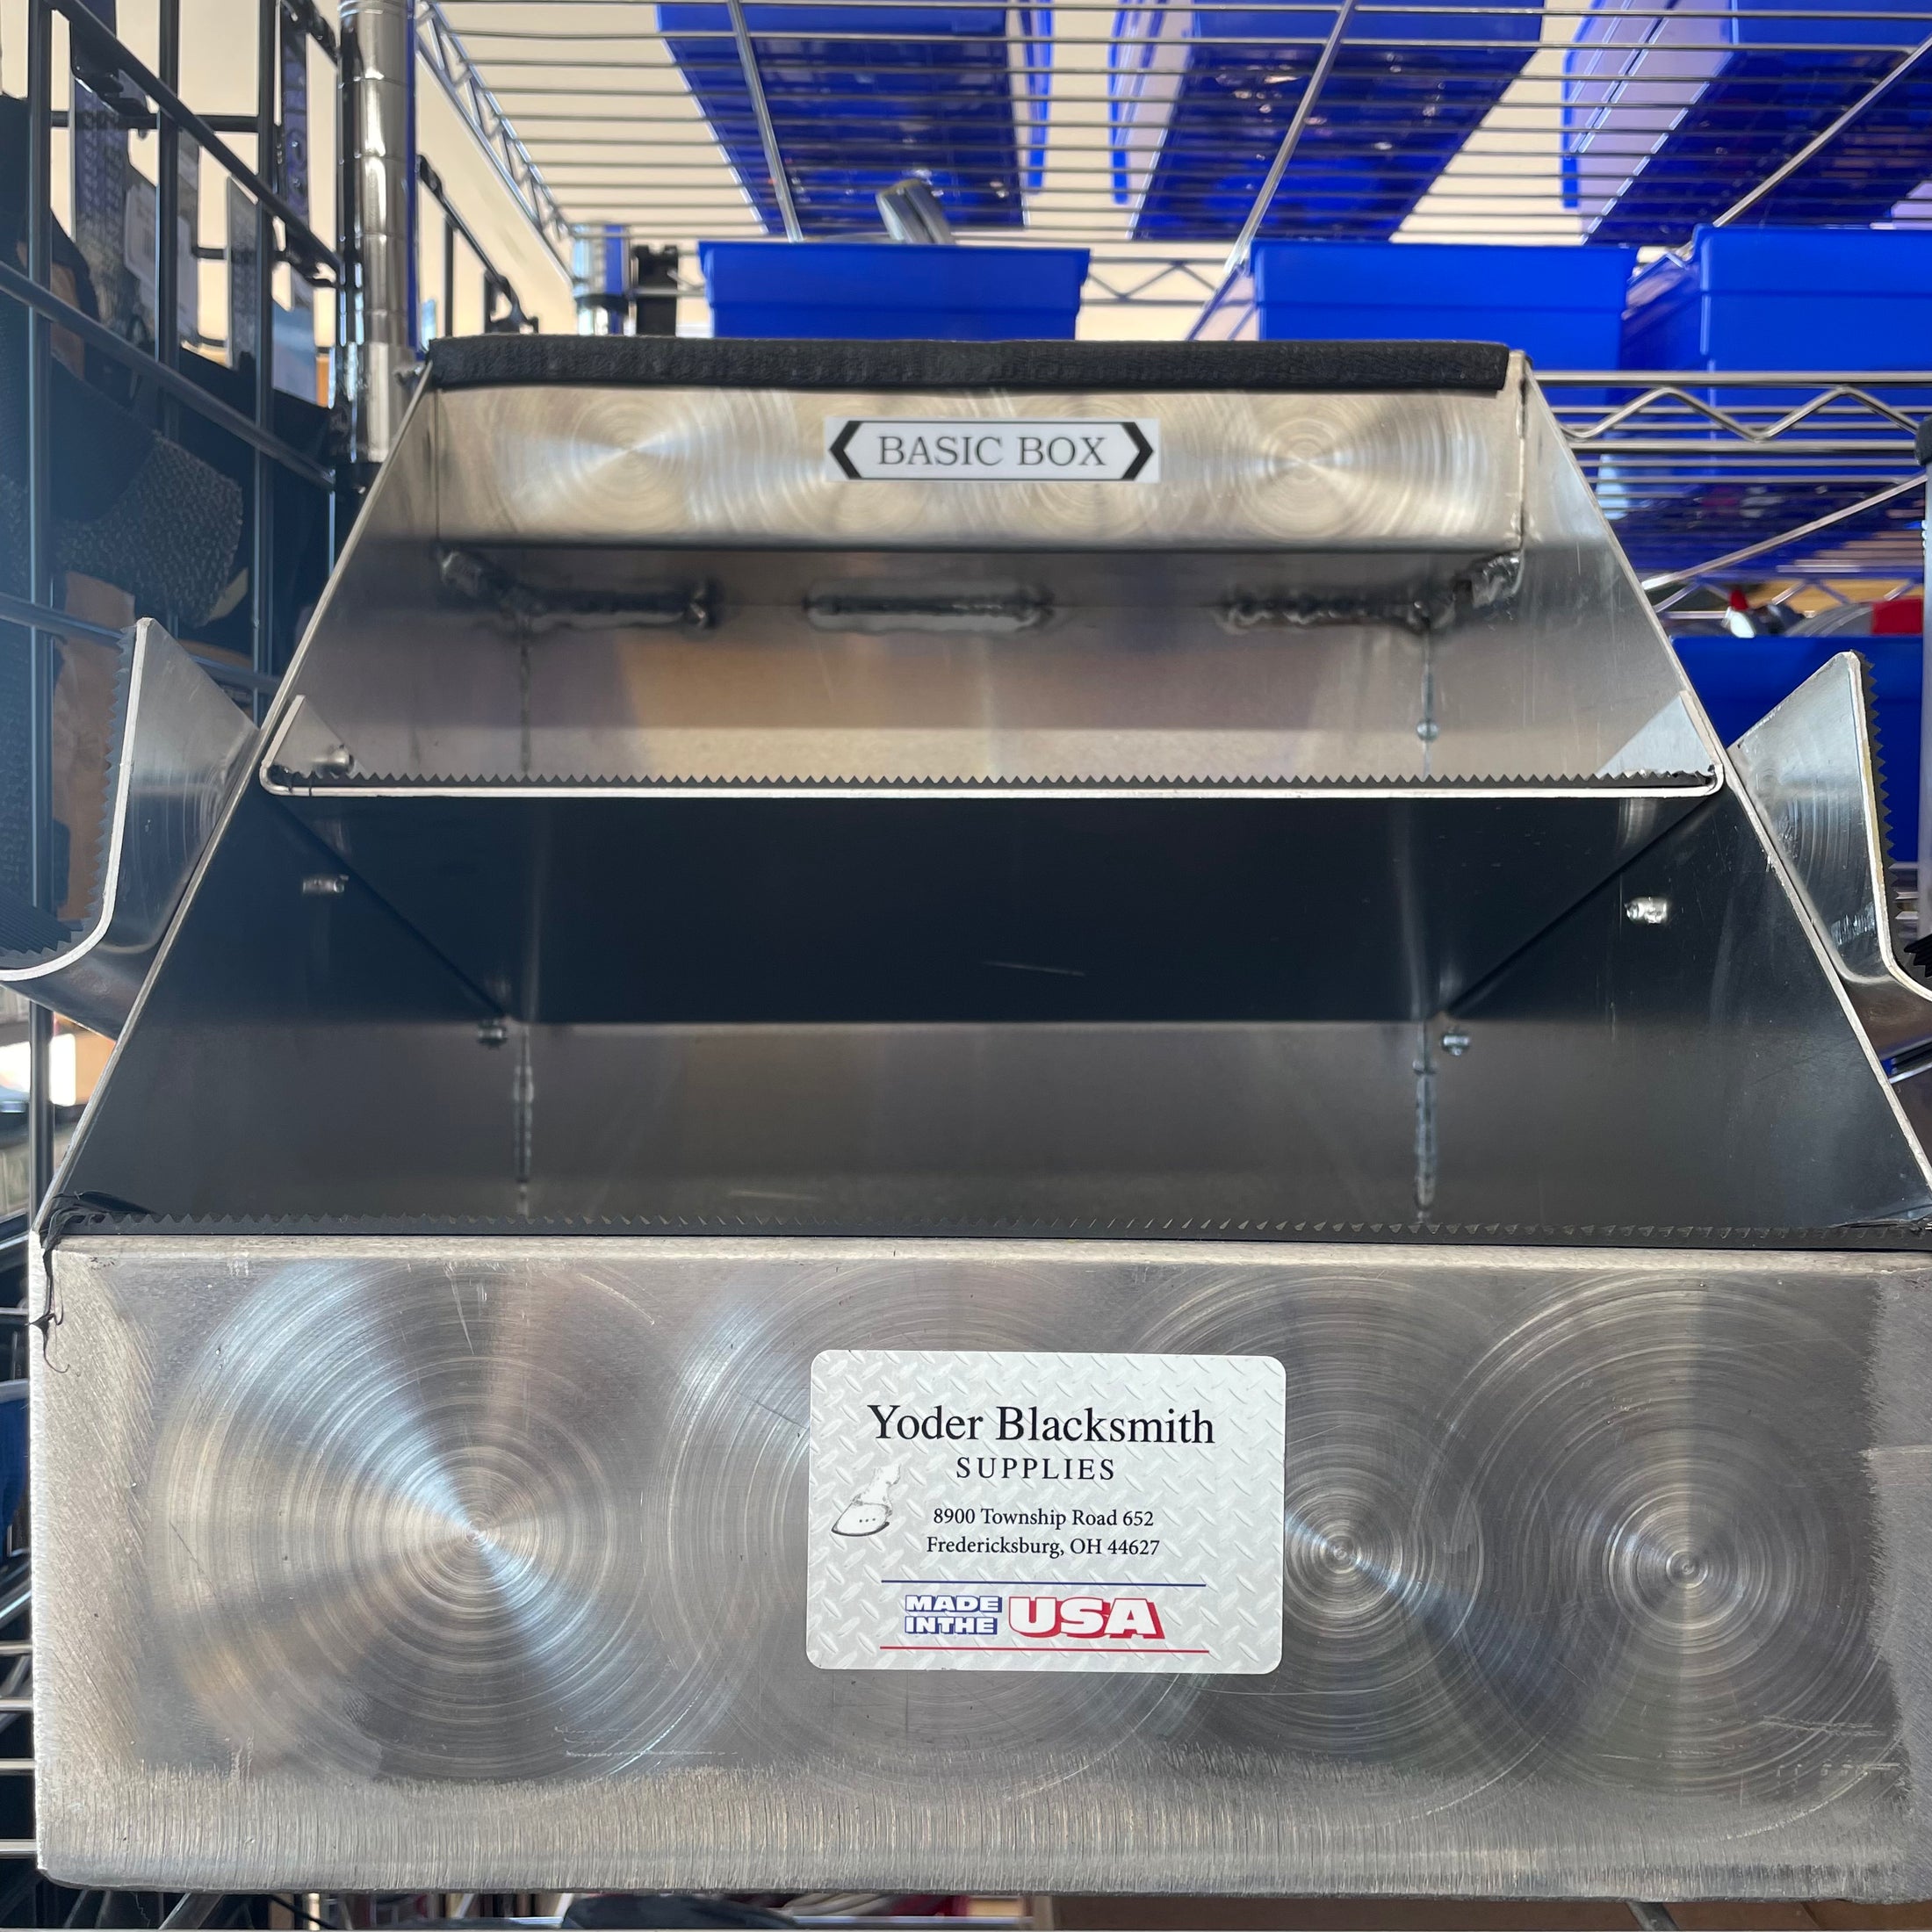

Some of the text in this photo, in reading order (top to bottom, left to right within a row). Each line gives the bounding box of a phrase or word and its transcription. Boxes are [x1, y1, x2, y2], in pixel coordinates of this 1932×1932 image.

[877, 436, 1107, 465] BASIC BOX
[867, 1405, 1215, 1444] Yoder Blacksmith
[955, 1457, 1115, 1480] SUPPLIES
[934, 1509, 1154, 1530] 8900 Township Road 652
[926, 1537, 1160, 1559] Fredericksburg, OH 44627
[905, 1595, 1002, 1613] MADE
[1008, 1597, 1165, 1640] USA
